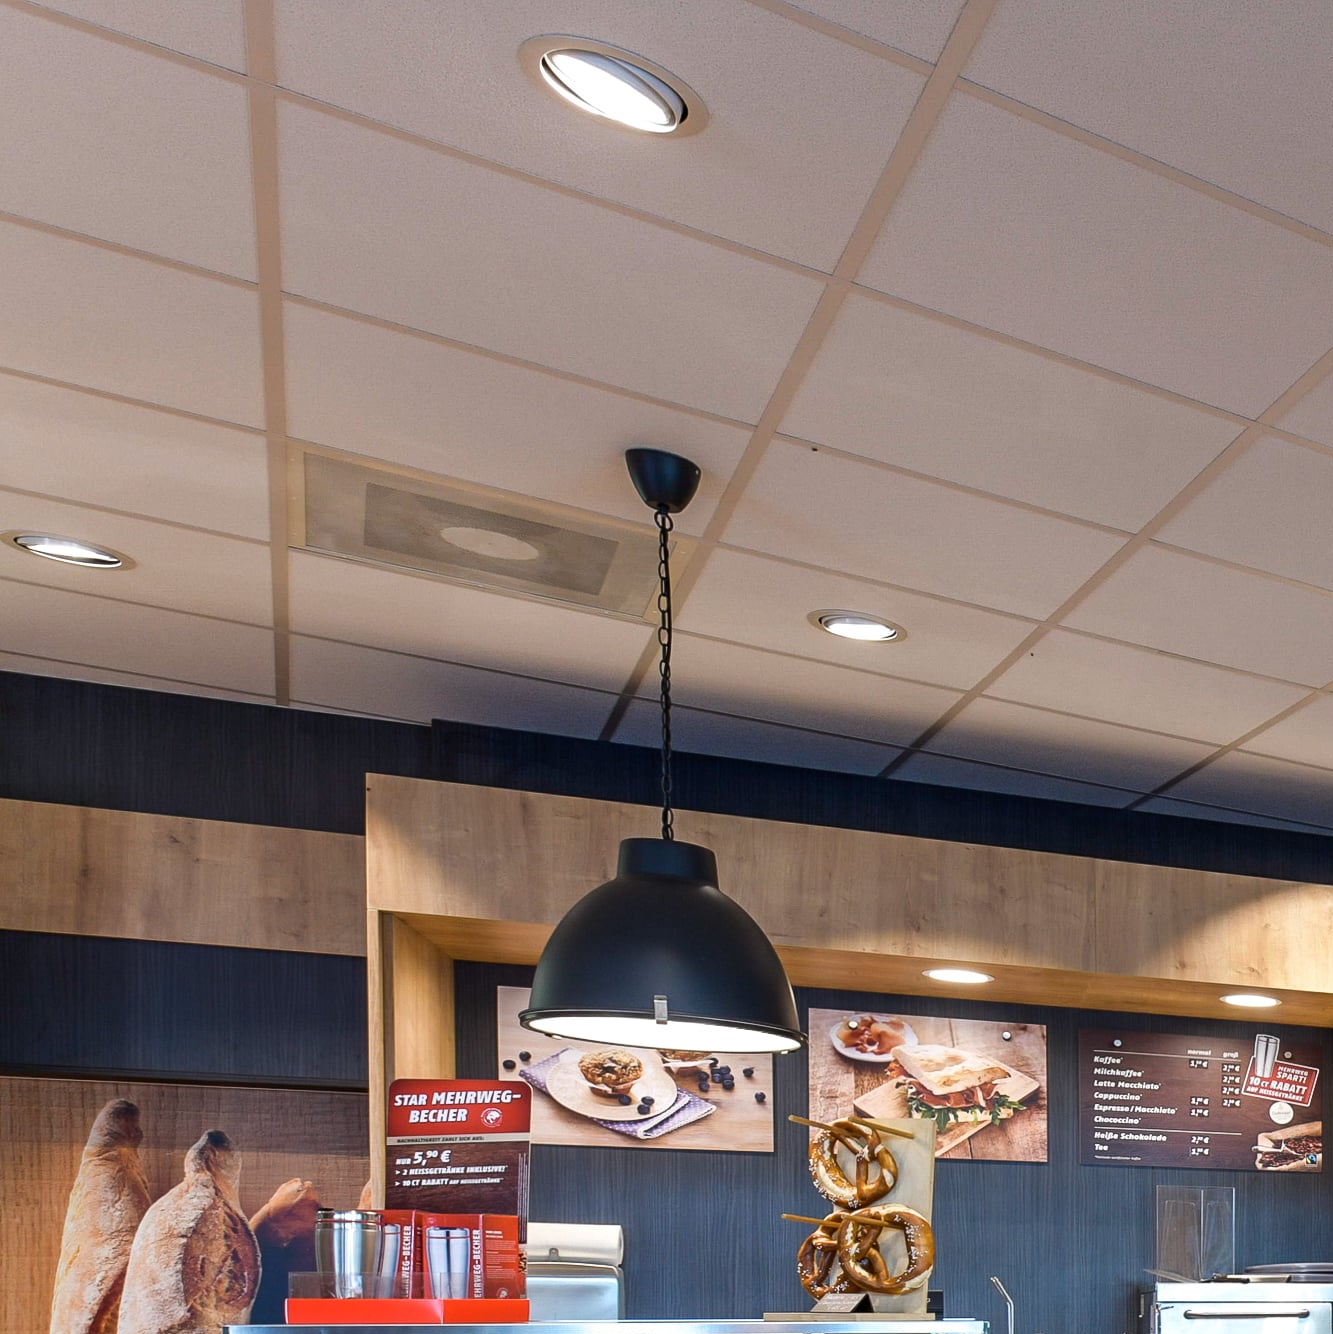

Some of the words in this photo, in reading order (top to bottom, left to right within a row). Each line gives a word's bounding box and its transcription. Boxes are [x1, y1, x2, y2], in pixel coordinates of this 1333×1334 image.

[1094, 1080, 1116, 1088] Latte
[1276, 1072, 1307, 1084] SPART!
[1249, 1076, 1261, 1086] 10
[1270, 1080, 1308, 1095] RABATT
[393, 1094, 428, 1107] STAR
[431, 1090, 522, 1105] MEHRWEG-
[408, 1108, 468, 1123] BECHER
[1094, 1132, 1119, 1140] Heiße
[1120, 1133, 1167, 1141] Schokolade
[413, 1150, 439, 1166] 5,90
[440, 1150, 451, 1162] €
[409, 1165, 464, 1175] HEISSGETRÄNKE
[421, 1178, 449, 1186] RABATT
